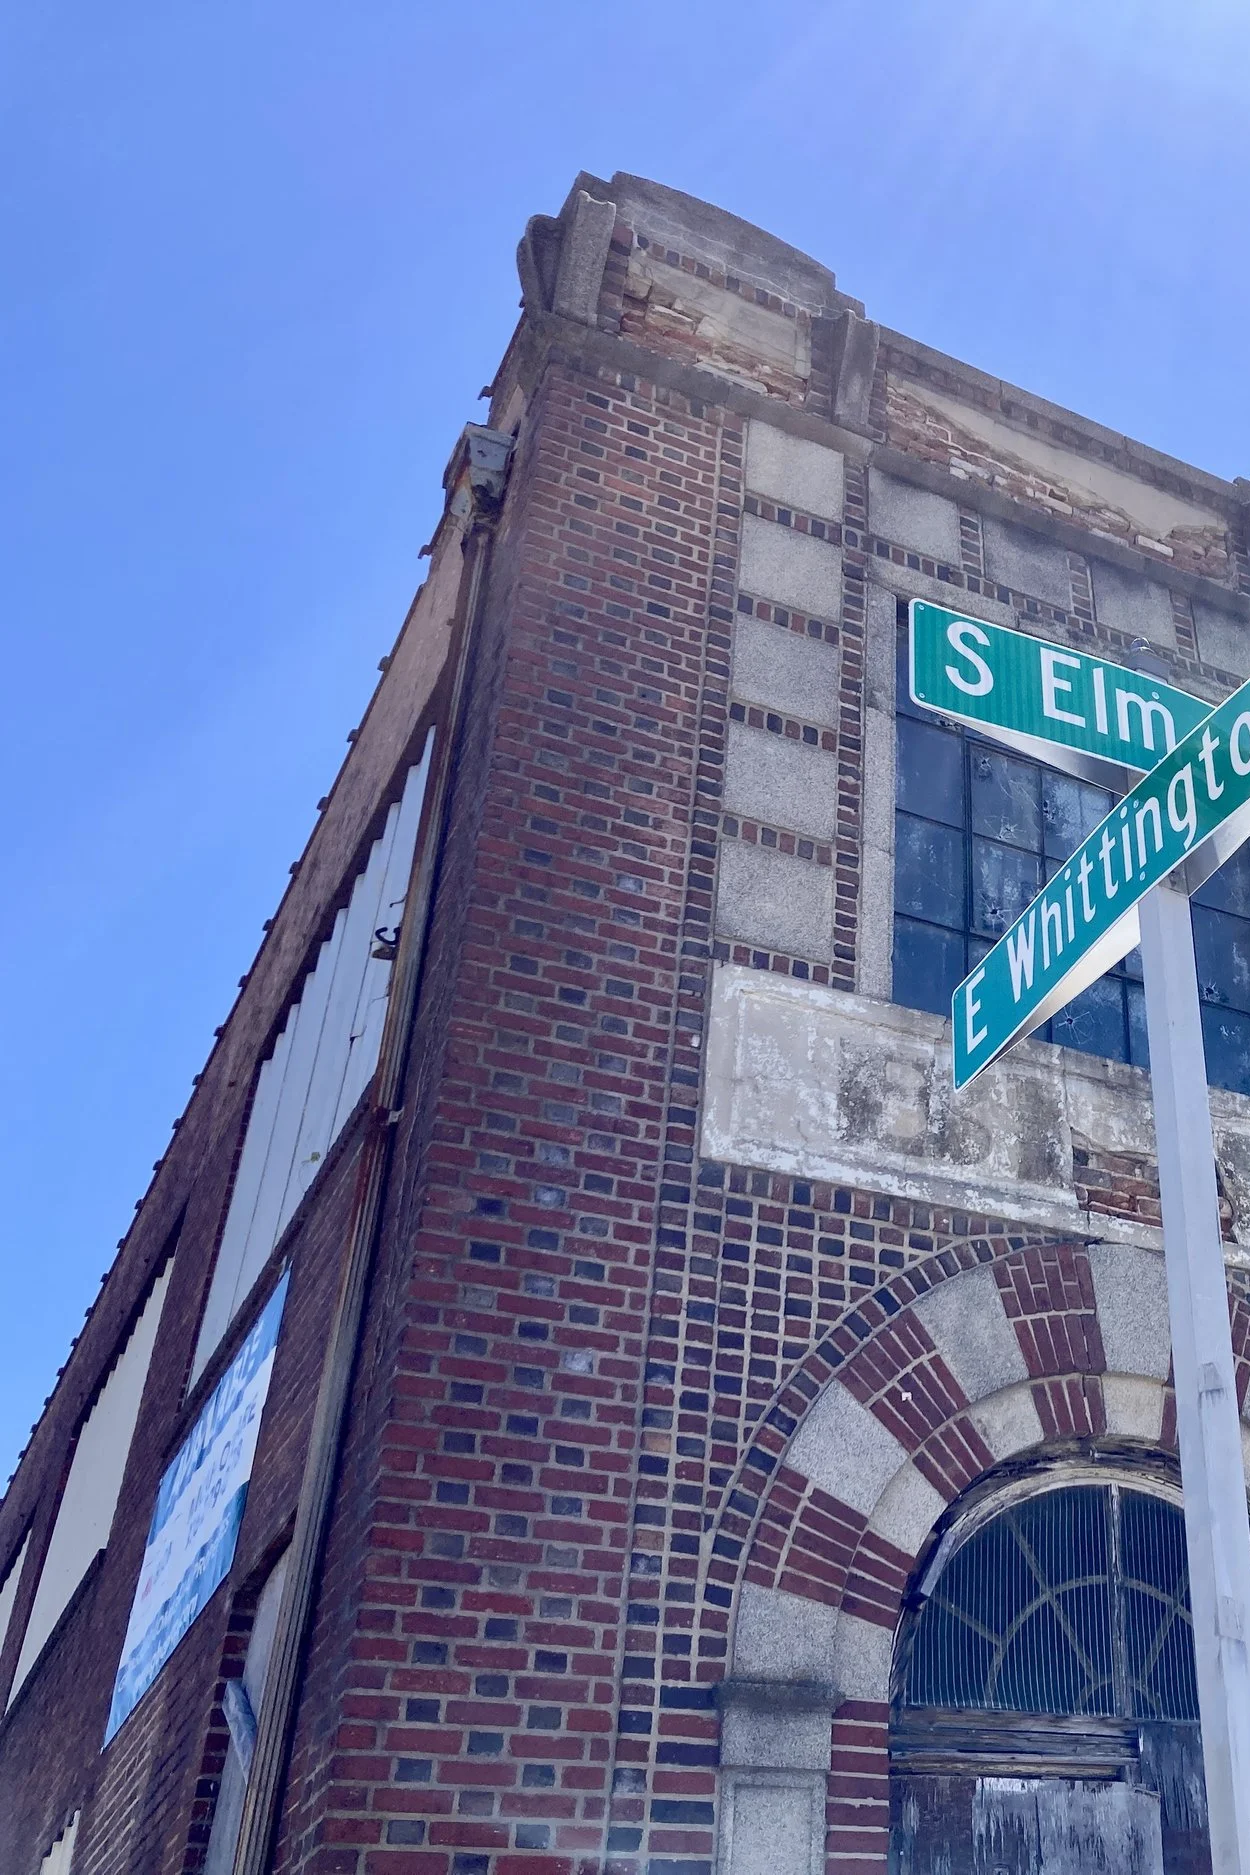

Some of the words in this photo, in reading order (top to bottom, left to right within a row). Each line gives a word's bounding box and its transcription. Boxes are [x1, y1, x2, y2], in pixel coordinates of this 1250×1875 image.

[945, 621, 995, 697] S
[1040, 648, 1176, 755] Elm
[966, 968, 988, 1055] E
